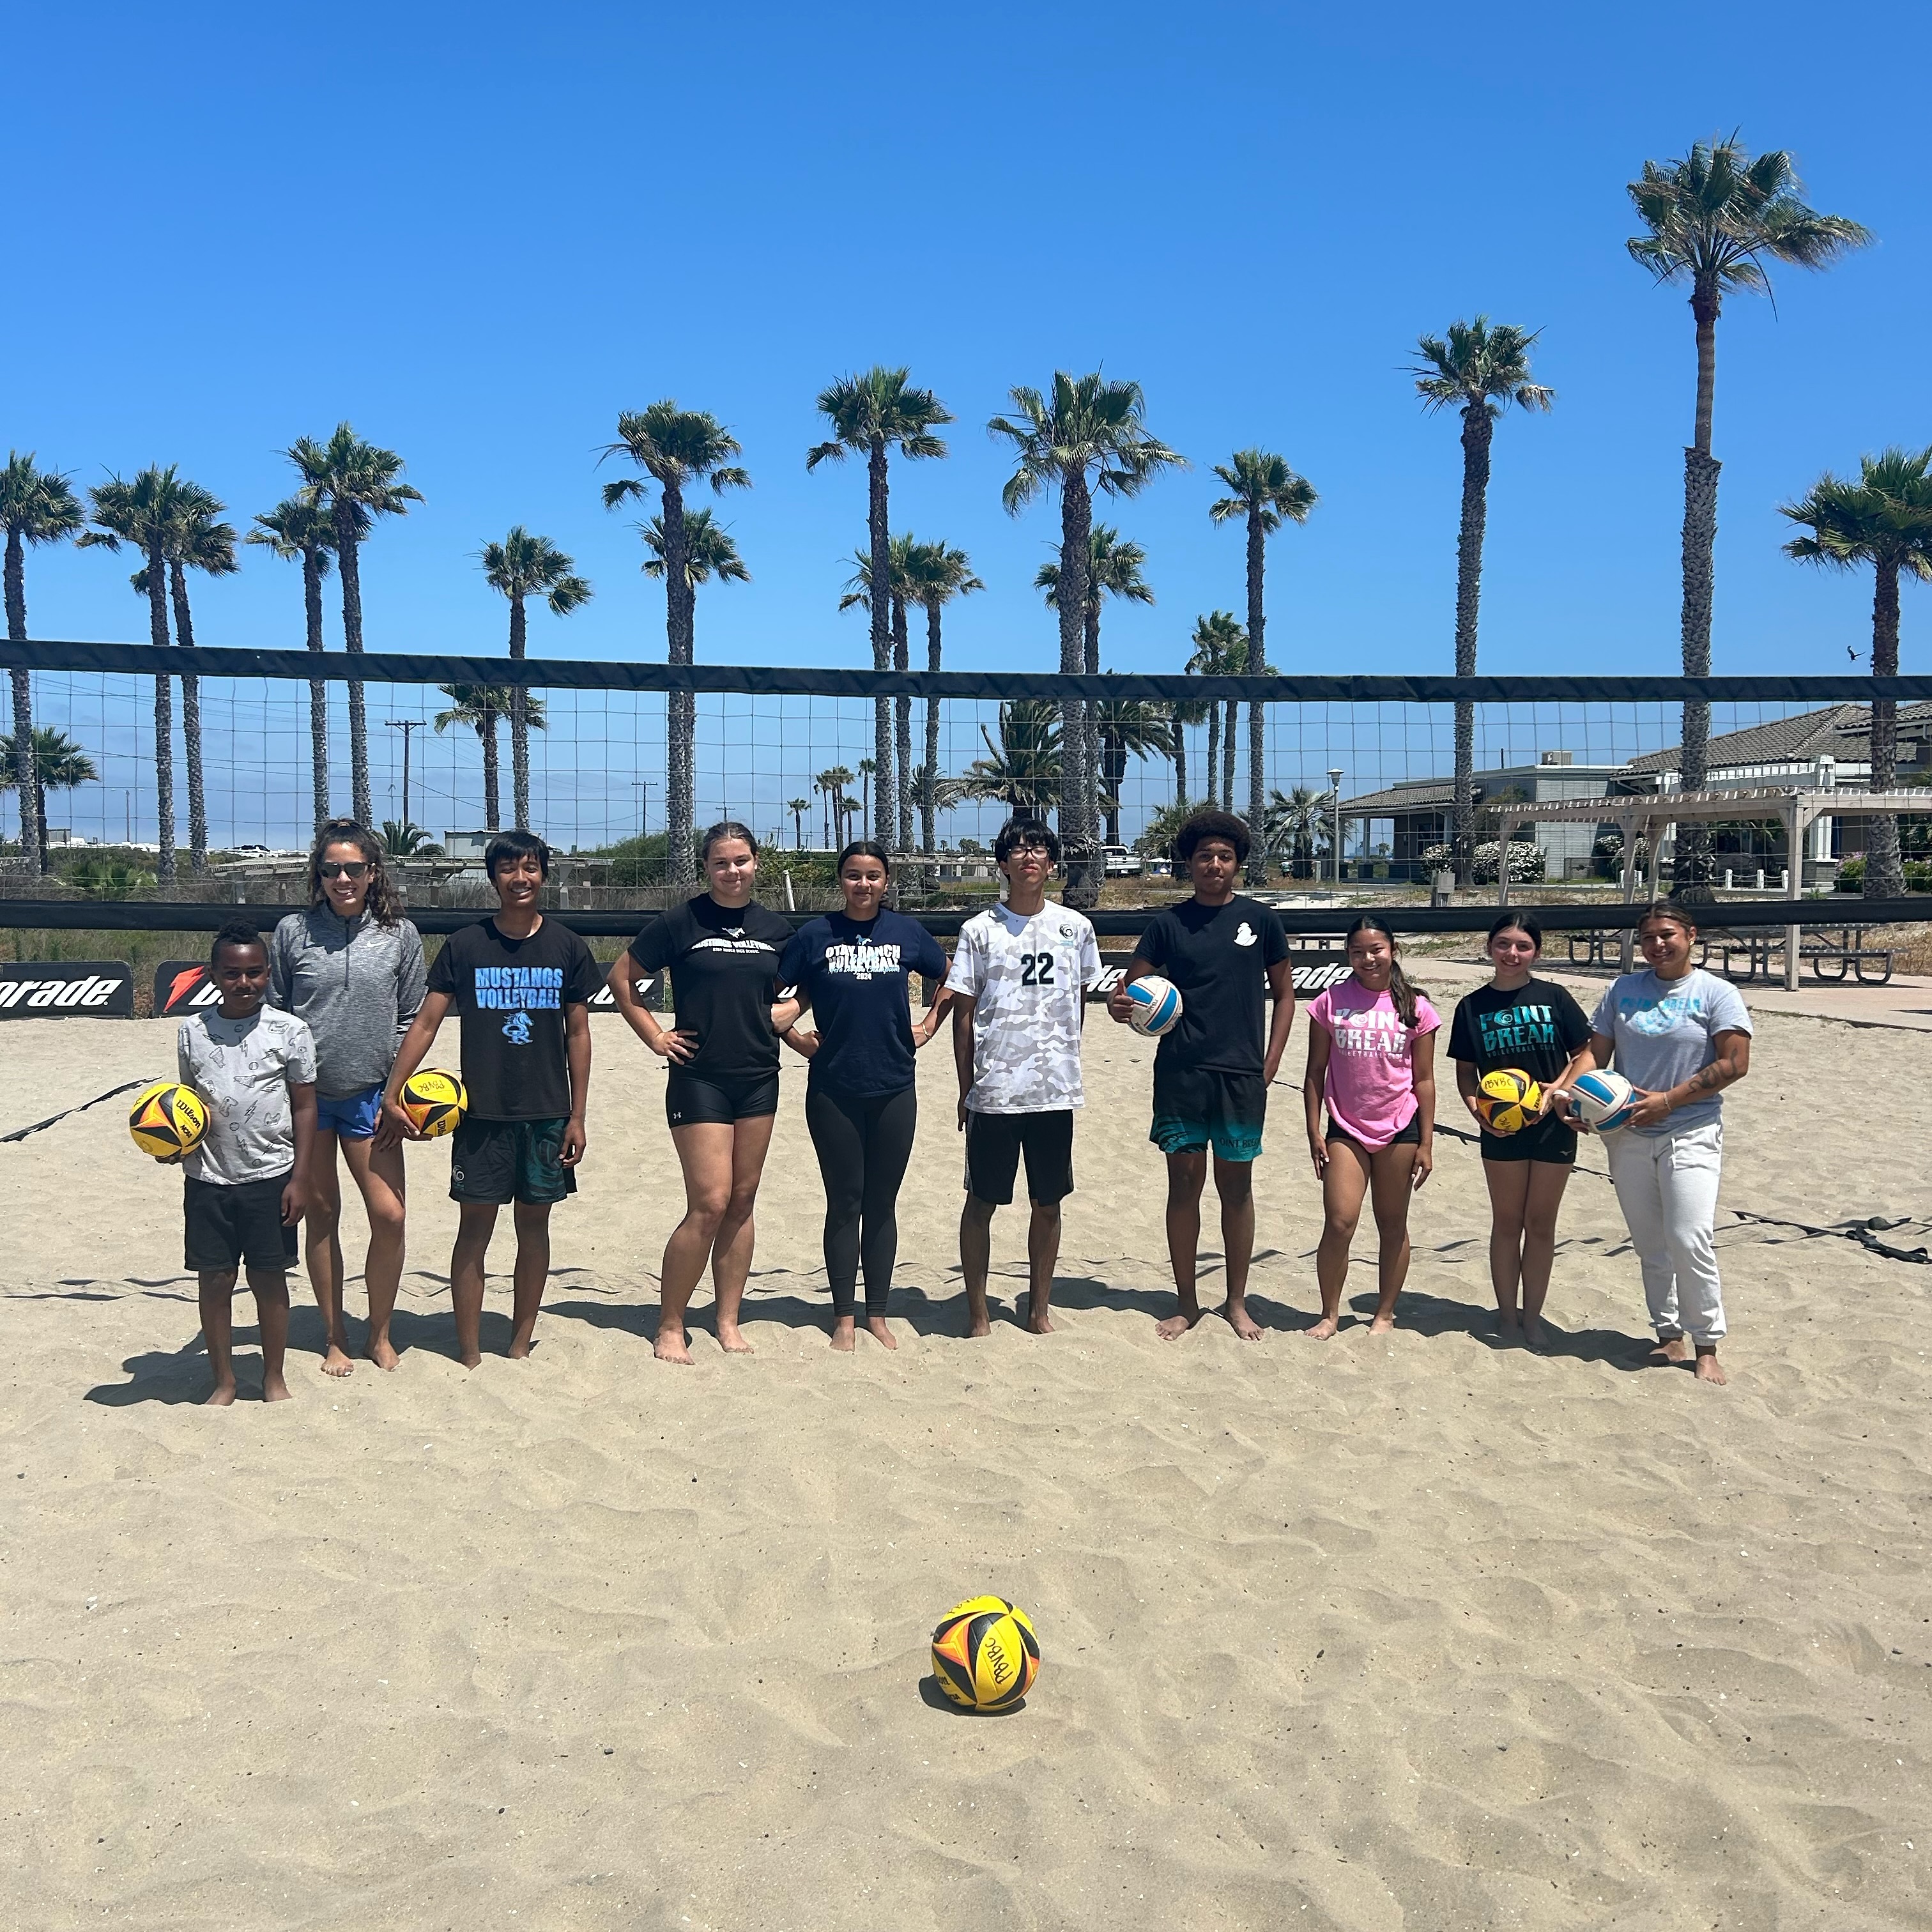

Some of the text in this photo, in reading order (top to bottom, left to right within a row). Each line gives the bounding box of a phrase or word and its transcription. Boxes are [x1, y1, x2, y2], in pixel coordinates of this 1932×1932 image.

[825, 944, 857, 958] OTAY
[857, 944, 901, 959] RANCH
[475, 967, 564, 989] MUSTANGS
[856, 972, 873, 981] 2024
[1021, 952, 1054, 986] 22
[475, 988, 561, 1009] VOLLEYBALL
[1479, 1005, 1552, 1032] POINT
[1335, 1029, 1407, 1054] BREAK
[1482, 1023, 1554, 1052] BREAK
[176, 1100, 201, 1130] Wilson
